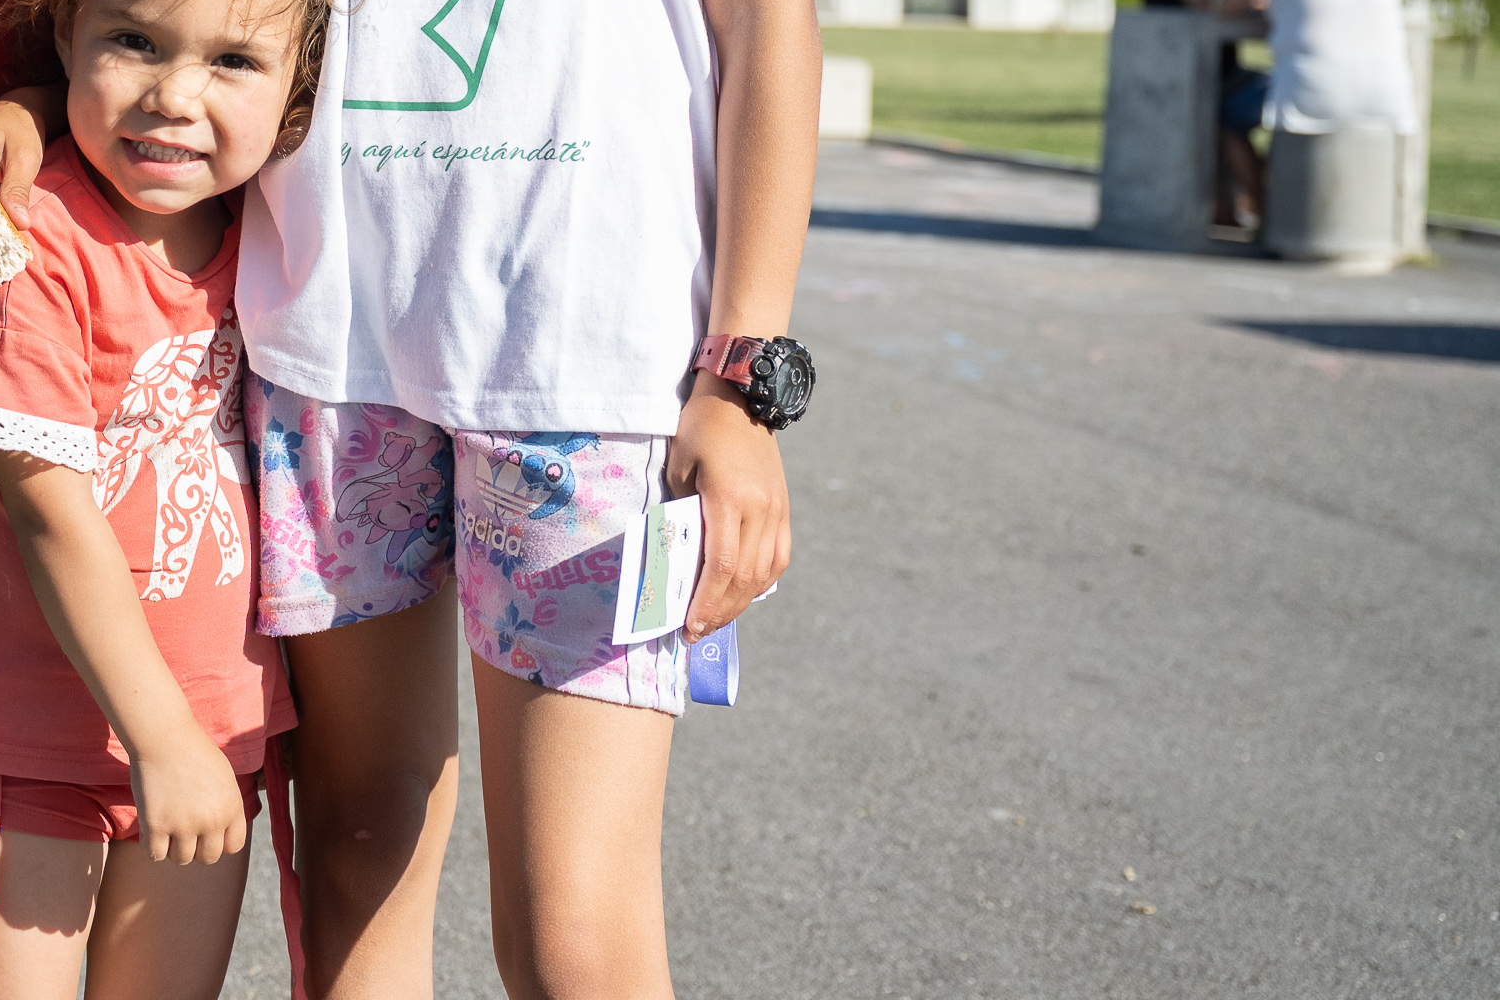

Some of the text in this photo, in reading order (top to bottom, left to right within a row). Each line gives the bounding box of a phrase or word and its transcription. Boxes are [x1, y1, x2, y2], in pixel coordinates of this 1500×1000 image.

[341, 142, 352, 167] y
[362, 140, 427, 173] aquí
[513, 550, 619, 599] Stitch
